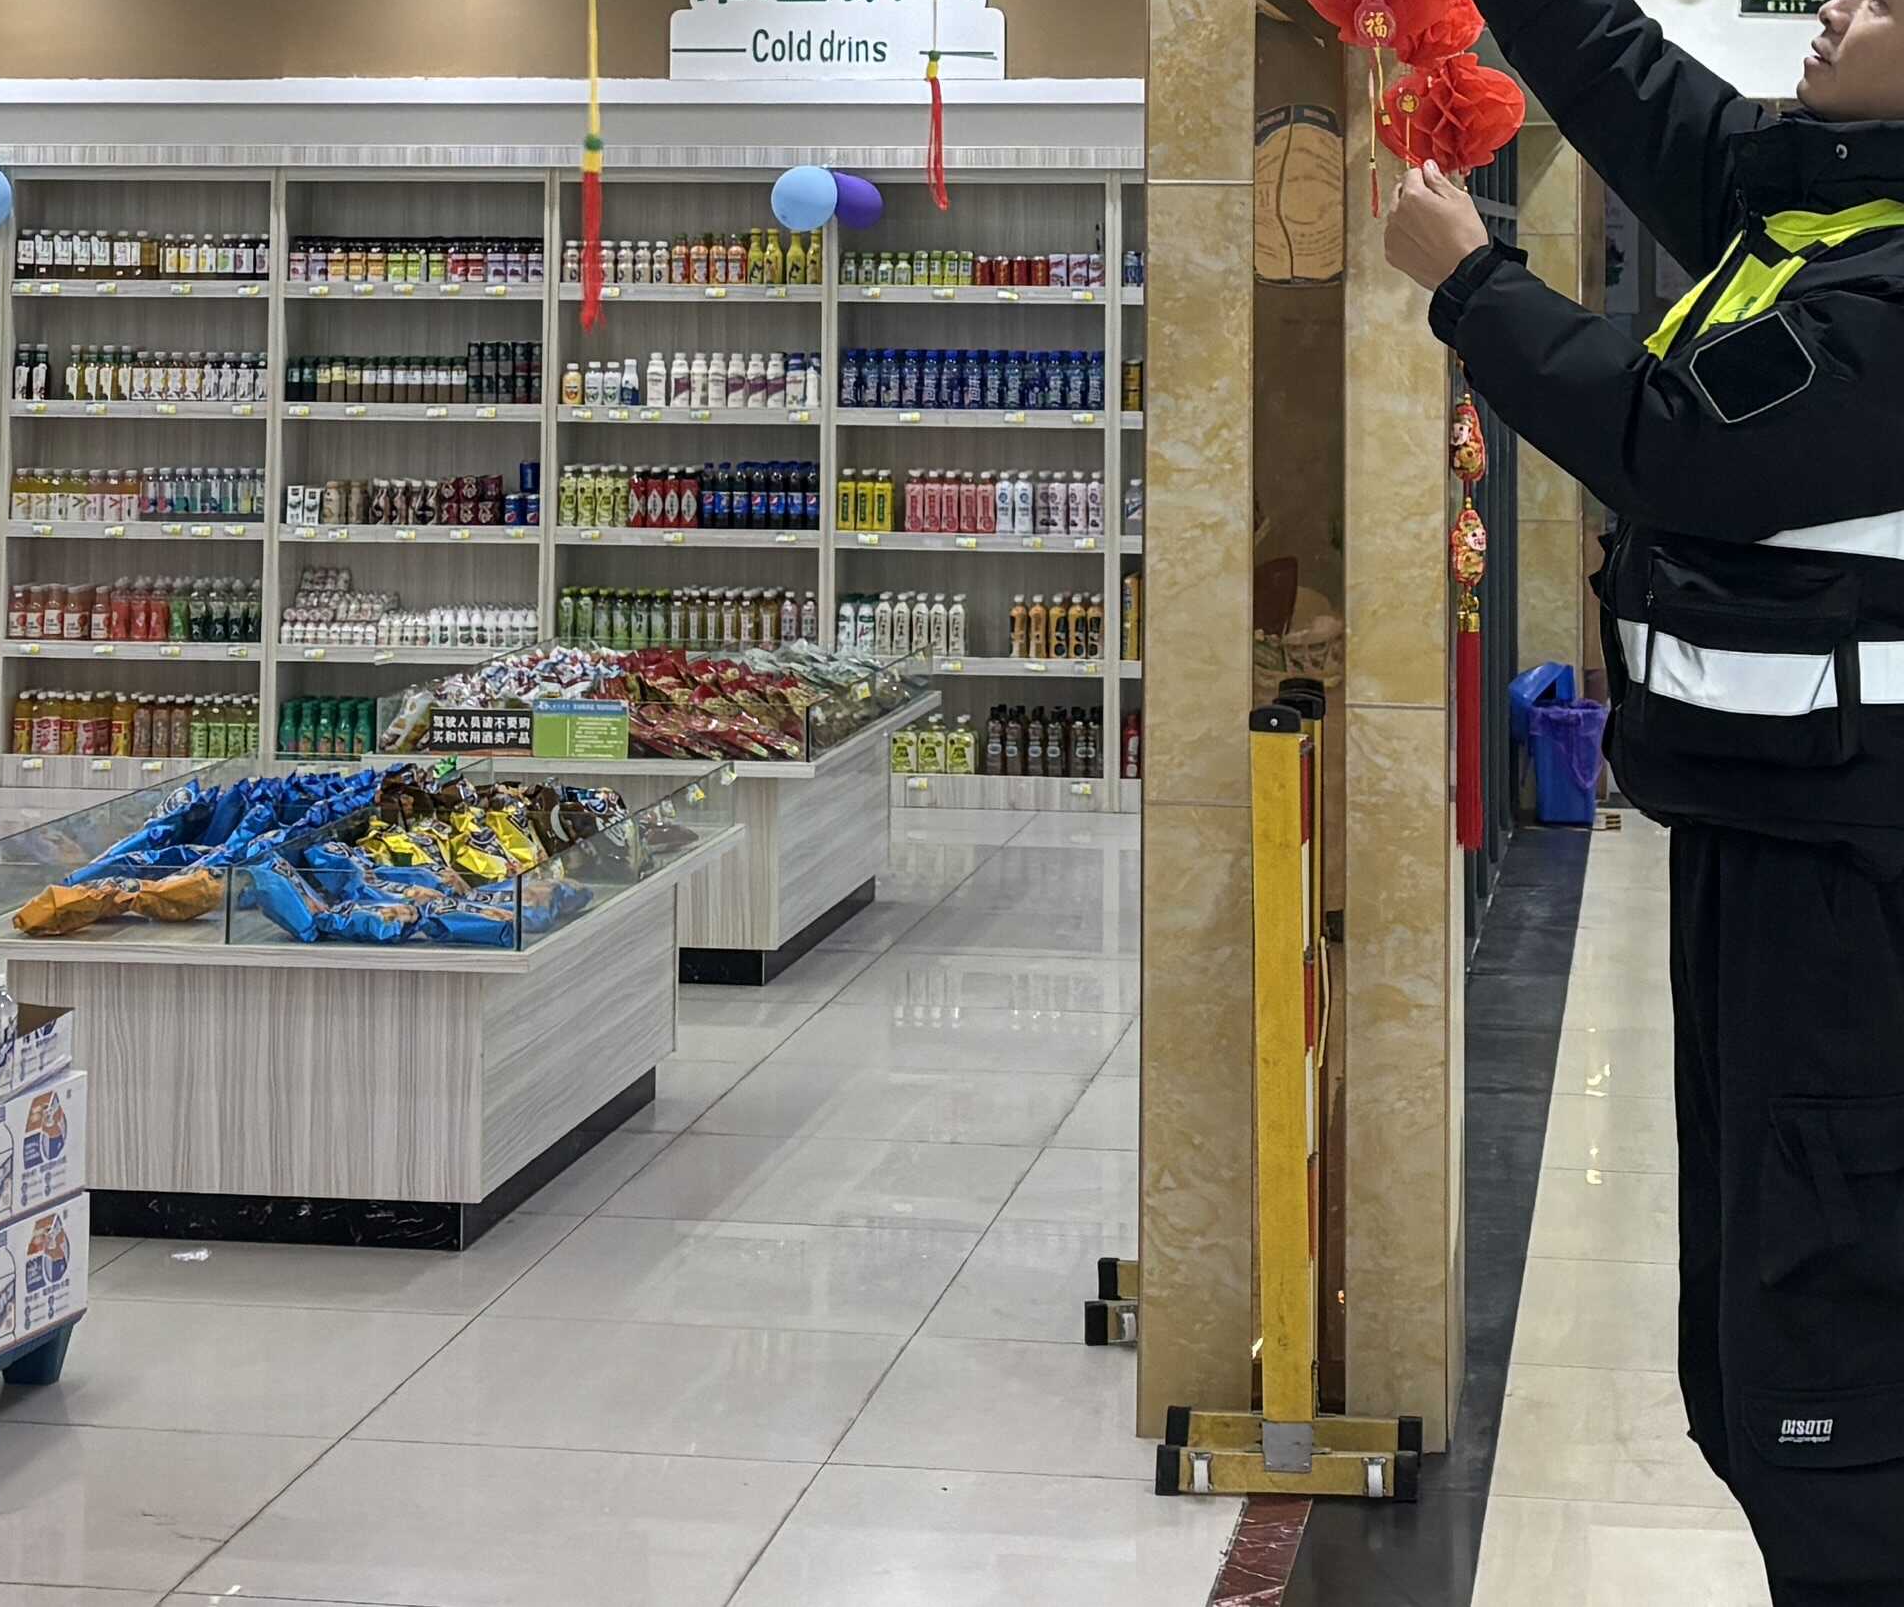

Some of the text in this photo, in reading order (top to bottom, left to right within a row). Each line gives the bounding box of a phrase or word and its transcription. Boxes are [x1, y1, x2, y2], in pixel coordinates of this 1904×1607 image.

[1767, 1, 1807, 12] EXIT
[1365, 11, 1387, 38] 福
[752, 29, 889, 63] Cold drins
[433, 715, 531, 729] 驾驶人员请不要购
[433, 731, 531, 745] 买和饮用酒类产品
